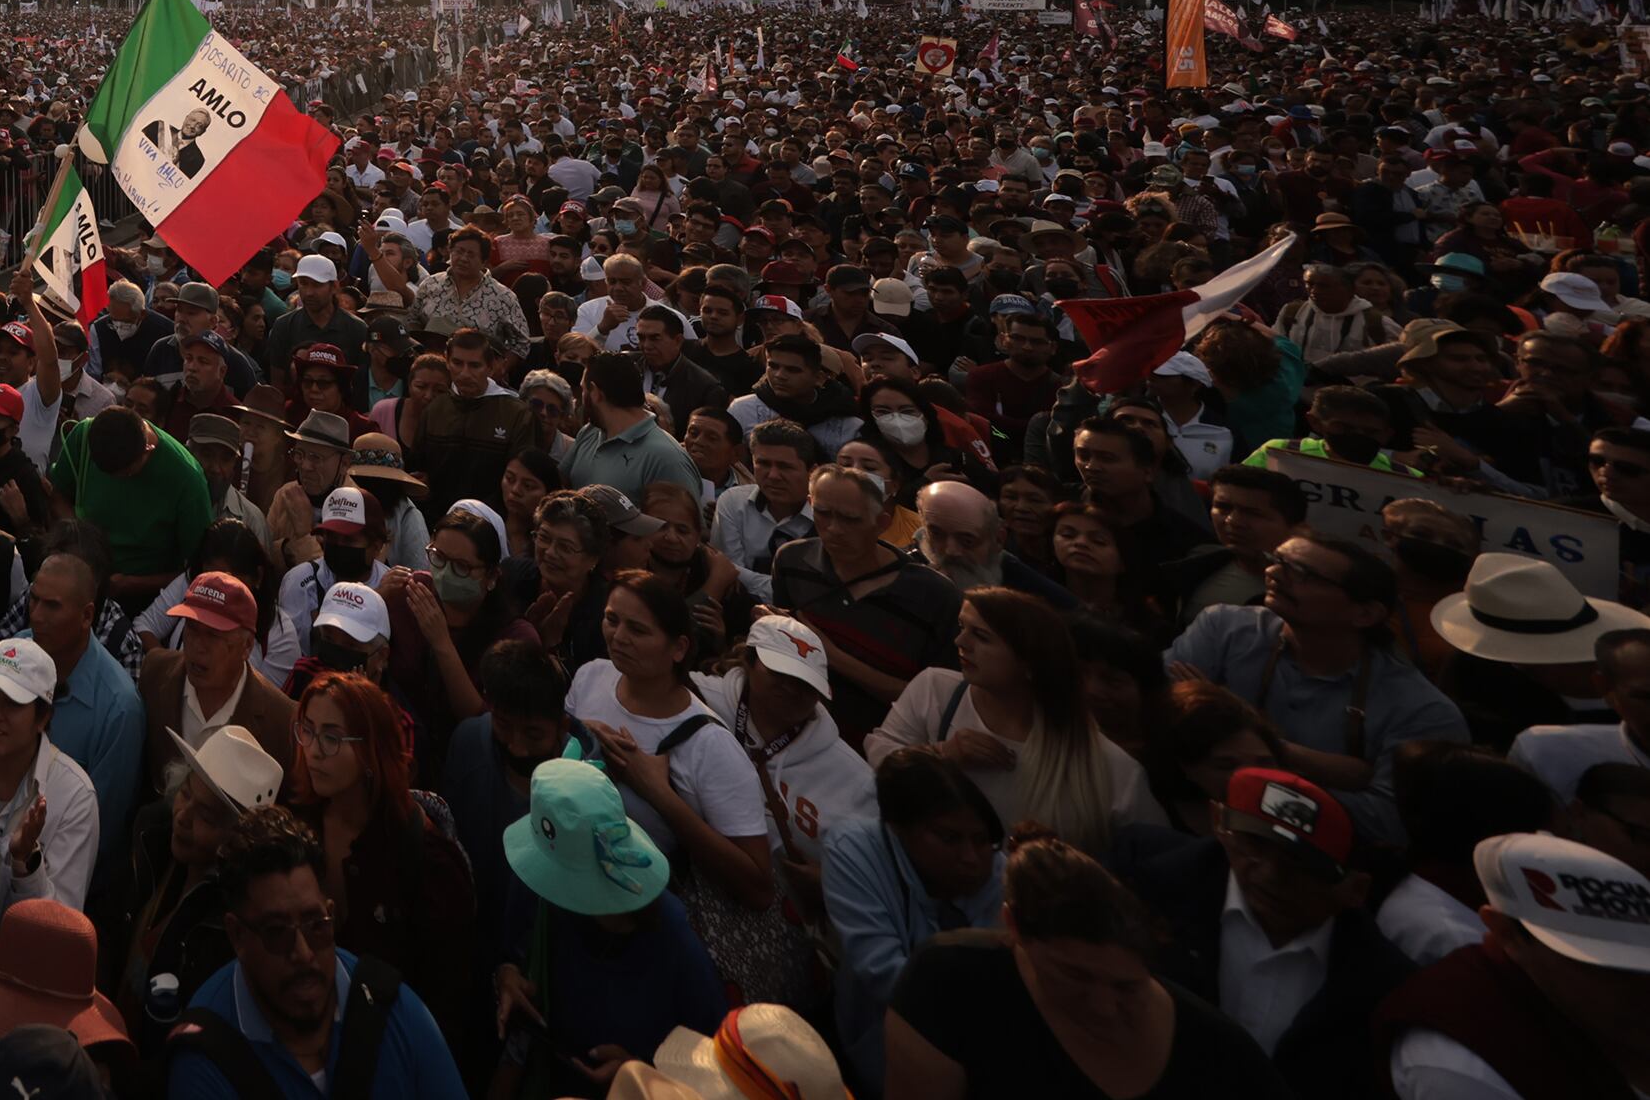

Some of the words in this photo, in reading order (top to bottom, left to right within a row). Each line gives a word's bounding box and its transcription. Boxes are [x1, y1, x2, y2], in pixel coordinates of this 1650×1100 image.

[199, 33, 251, 90] ROSARITO
[188, 78, 246, 129] AMLO
[138, 137, 158, 162] VIVA
[310, 350, 337, 362] morena
[328, 496, 359, 509] Delfina
[194, 584, 226, 601] morena
[333, 589, 365, 605] AMLO
